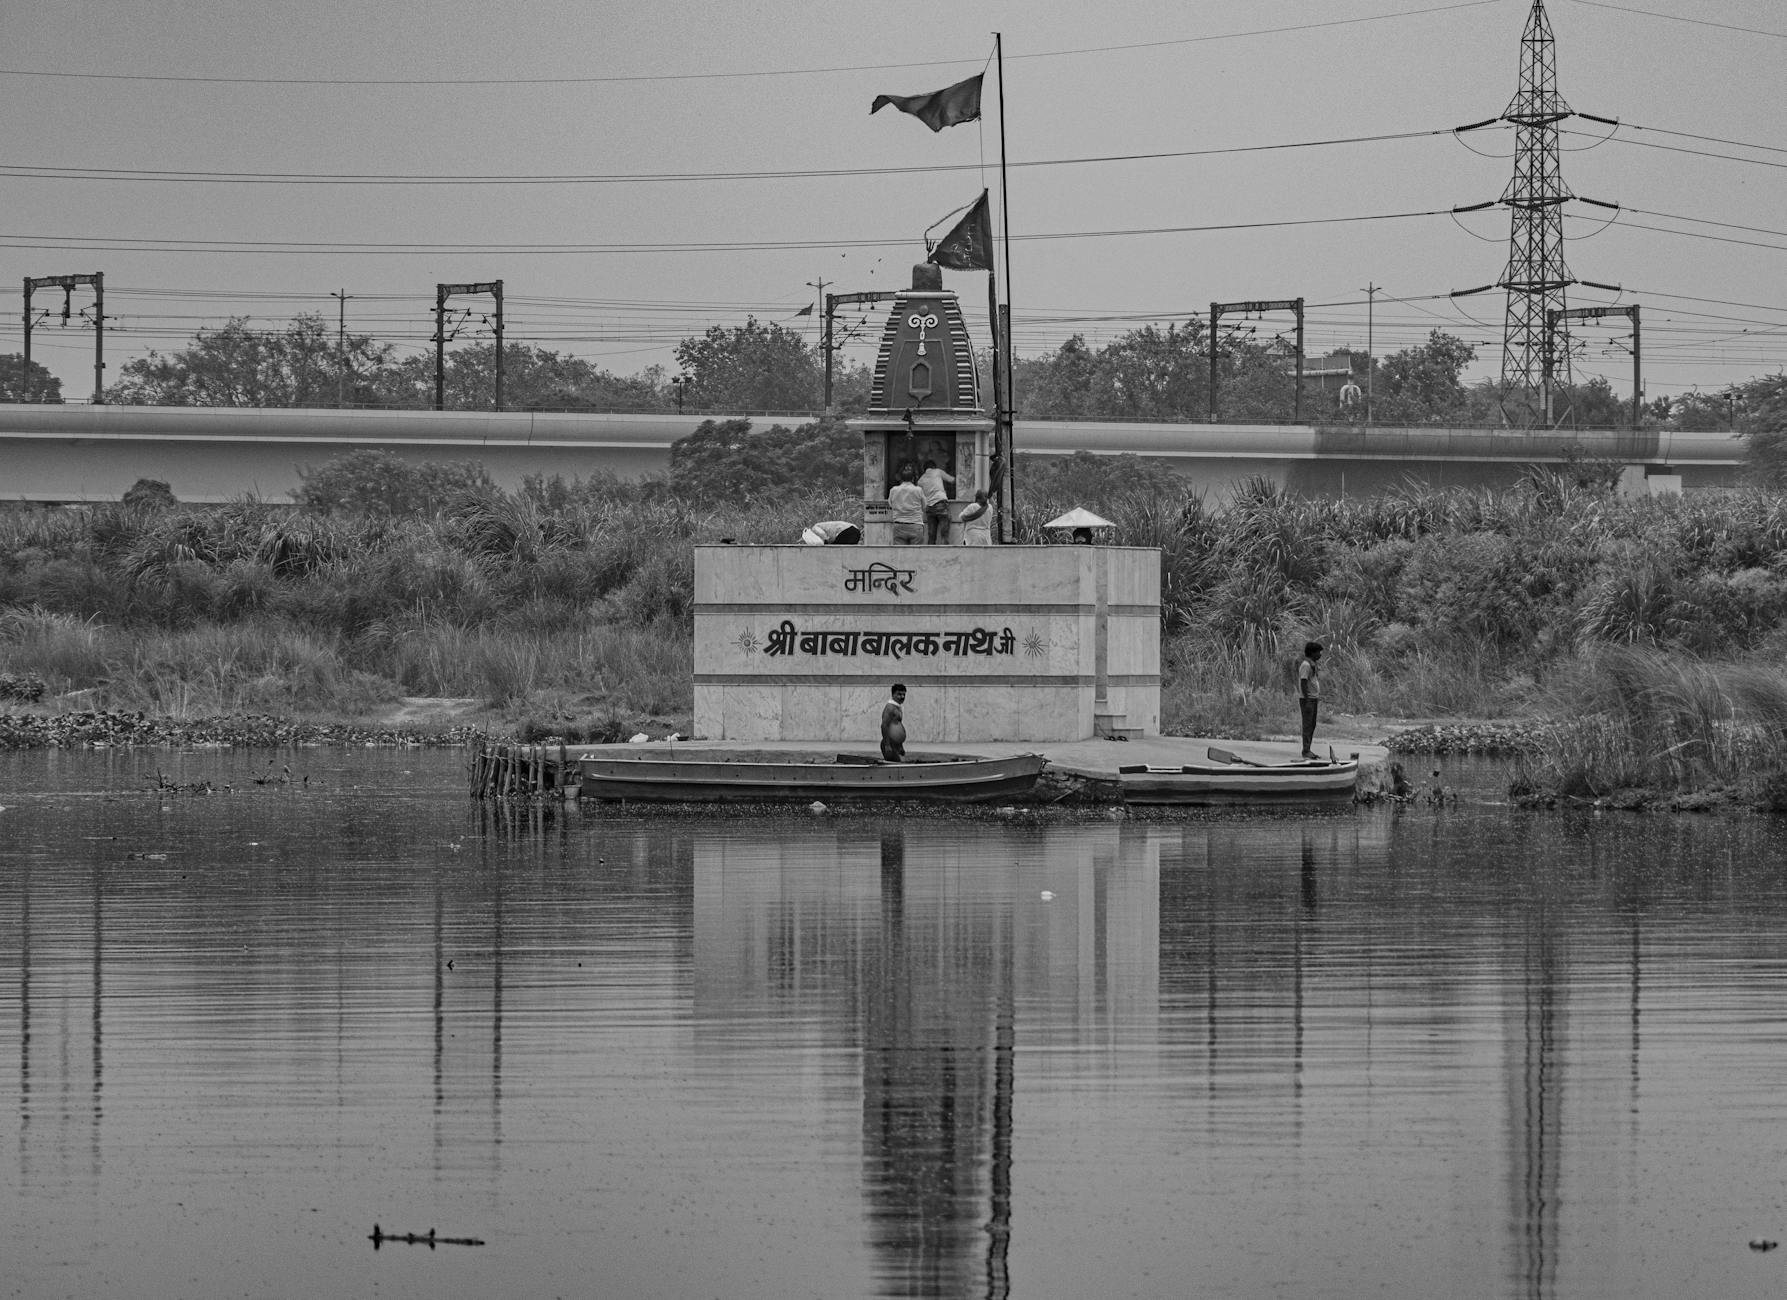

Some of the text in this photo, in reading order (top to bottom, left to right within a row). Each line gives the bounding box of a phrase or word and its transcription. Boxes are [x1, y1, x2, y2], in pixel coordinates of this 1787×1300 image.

[844, 562, 916, 597] मन्दिर
[763, 620, 798, 658] श्री
[799, 631, 861, 657] बाबा
